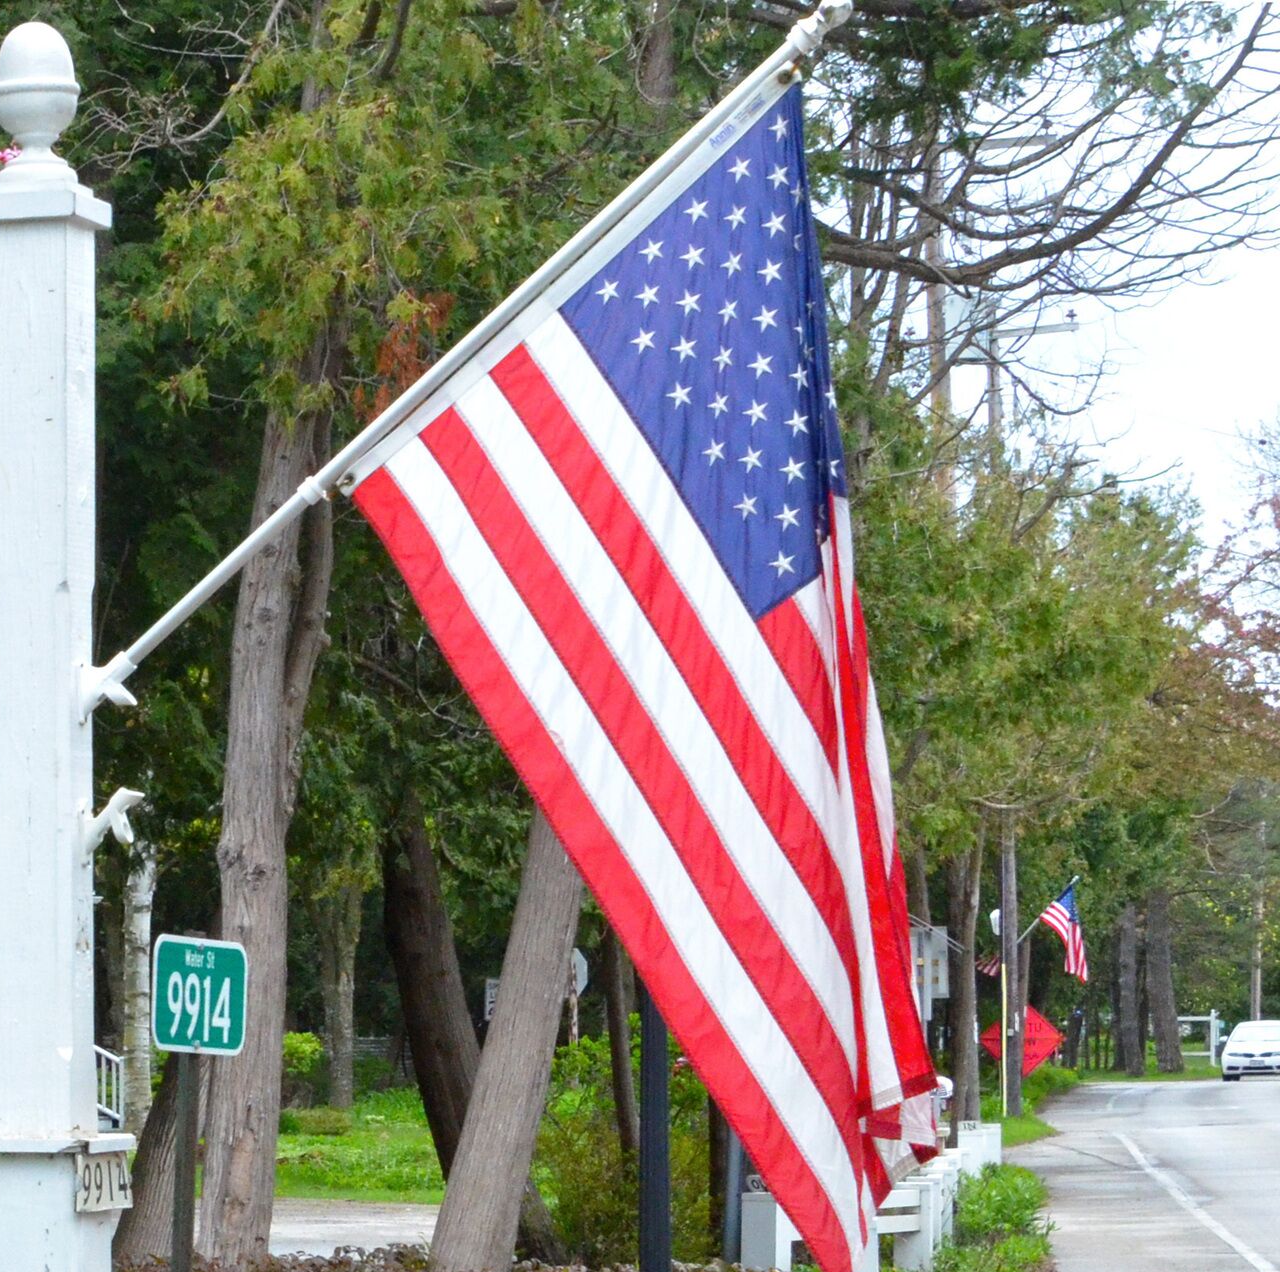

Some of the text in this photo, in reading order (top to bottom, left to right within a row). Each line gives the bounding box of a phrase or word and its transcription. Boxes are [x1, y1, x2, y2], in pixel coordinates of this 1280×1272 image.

[184, 949, 216, 969] Water St
[167, 971, 232, 1044] 9914
[82, 1160, 129, 1206] 9914
